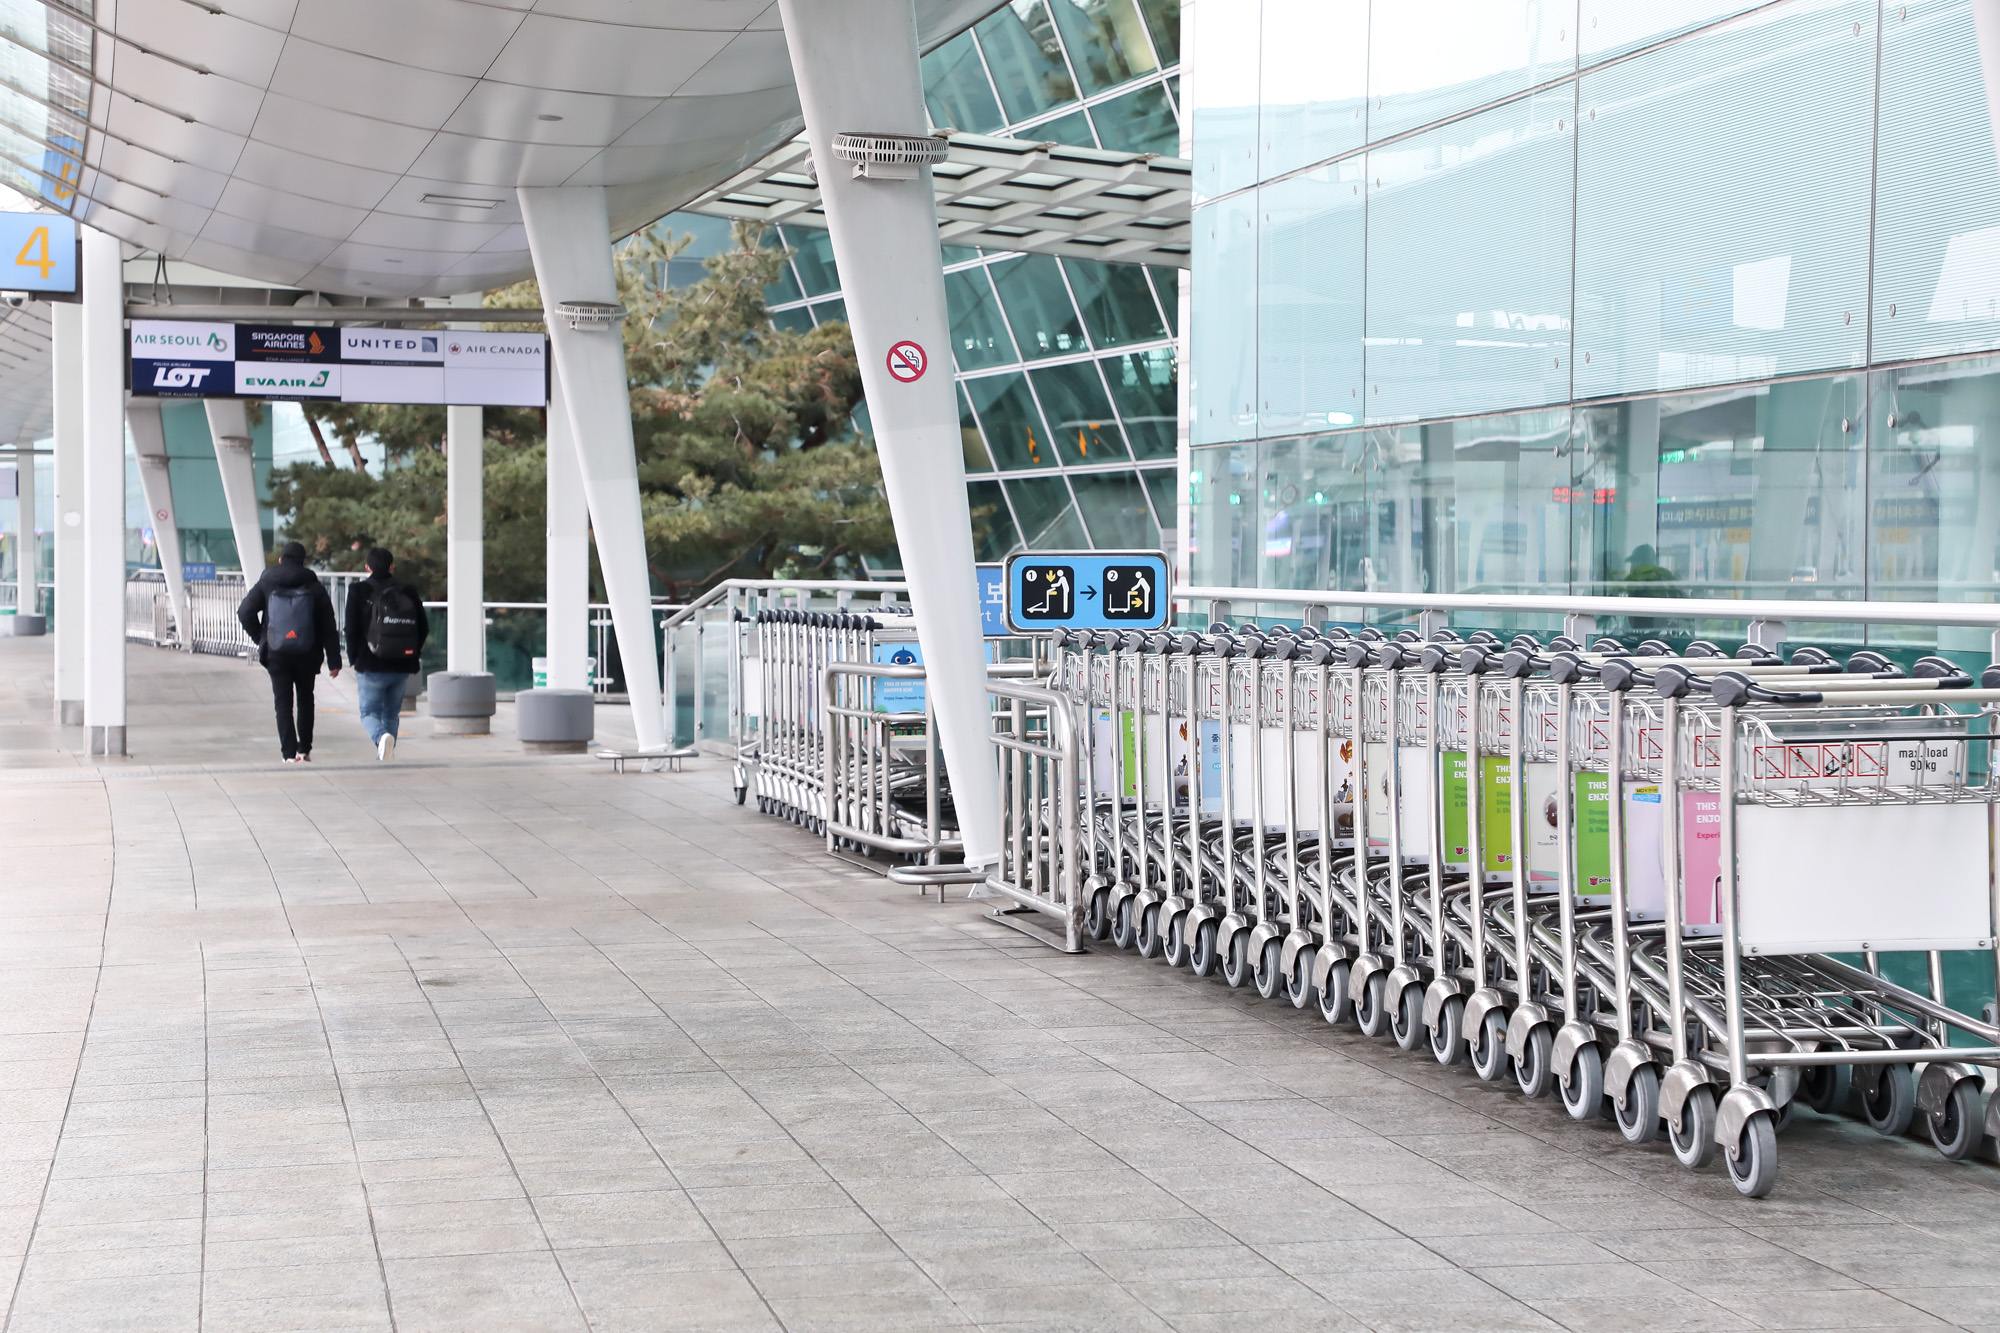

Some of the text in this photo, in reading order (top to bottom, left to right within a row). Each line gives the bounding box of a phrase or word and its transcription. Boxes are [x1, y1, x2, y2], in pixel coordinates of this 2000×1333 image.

[15, 226, 56, 279] 4
[134, 334, 202, 346] AIR SEOUL
[252, 332, 305, 342] SINGAPORE
[264, 341, 305, 349] AIRLINES
[348, 338, 417, 350] UNITED
[466, 345, 541, 355] AIR CANADA
[153, 367, 211, 388] LOT
[245, 377, 306, 387] EVA AIR
[1926, 747, 1948, 758] load
[1910, 760, 1937, 772] 90 kg
[1588, 781, 1607, 790] THIS
[1588, 793, 1609, 801] ENJO
[1696, 802, 1717, 811] THIS
[1696, 814, 1720, 823] ENJO
[1696, 832, 1720, 840] Experi
